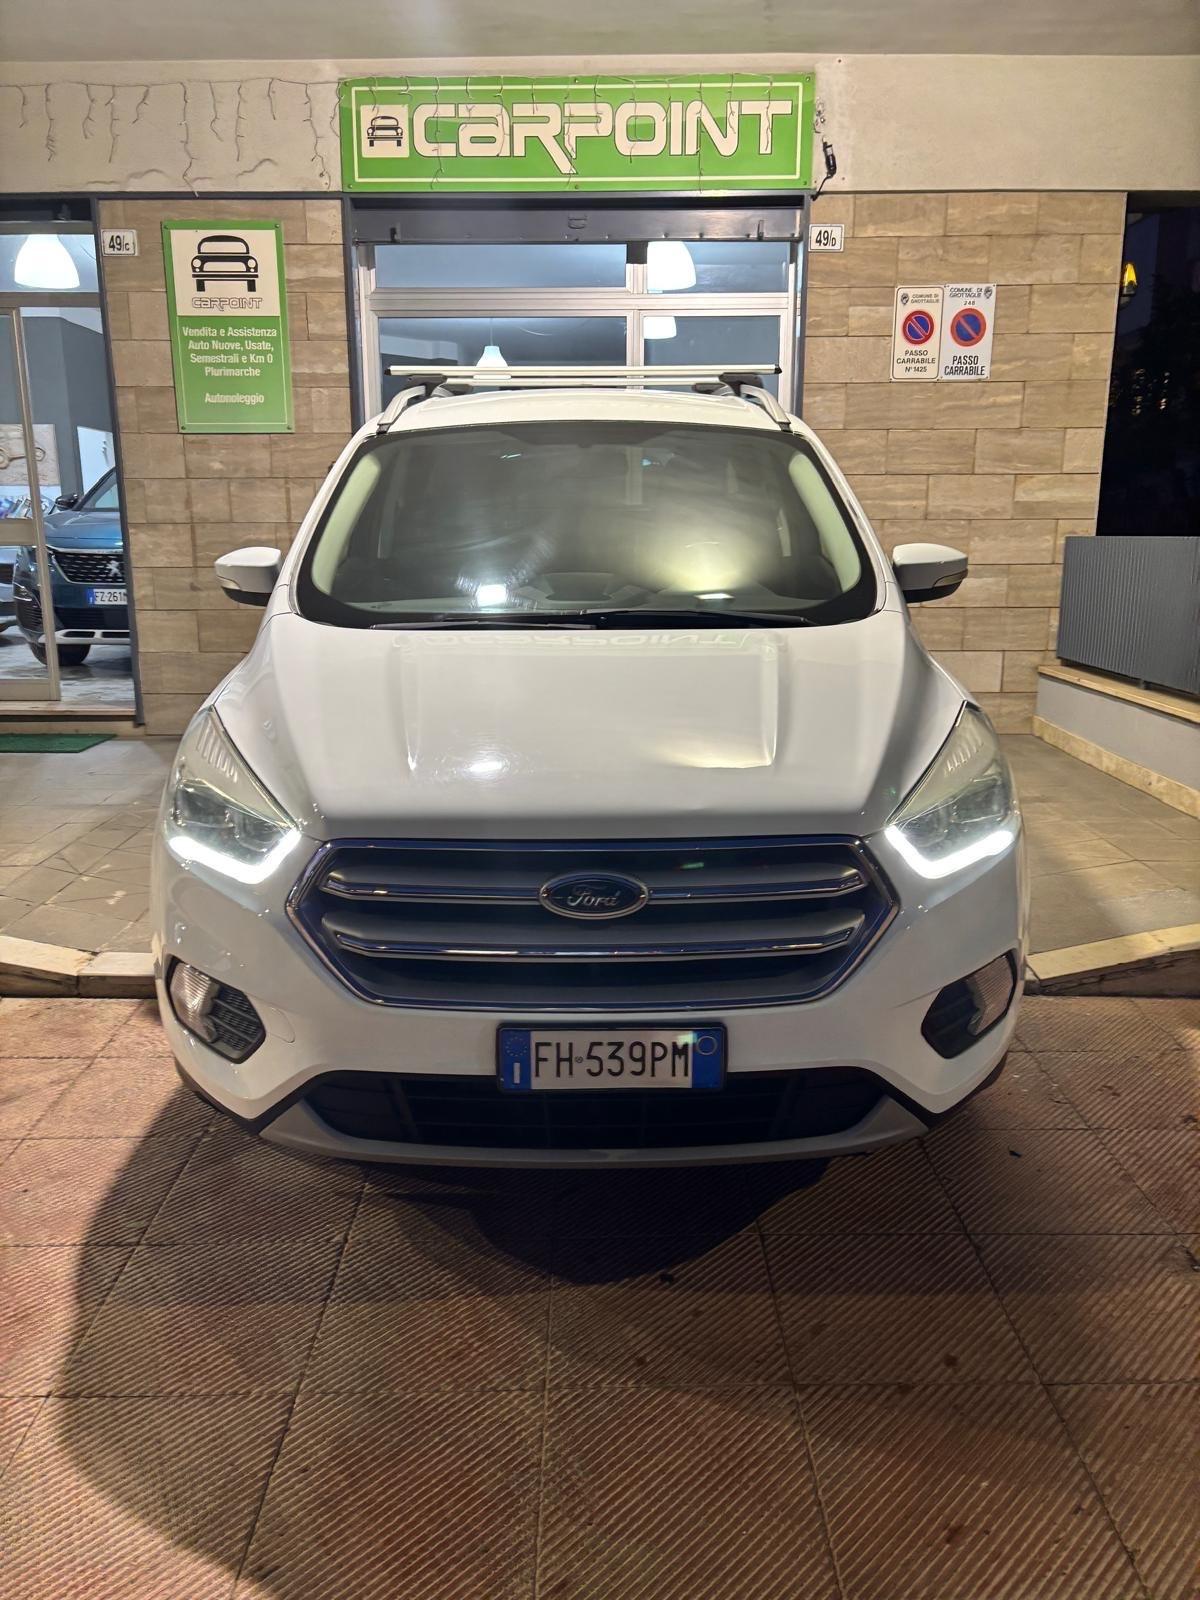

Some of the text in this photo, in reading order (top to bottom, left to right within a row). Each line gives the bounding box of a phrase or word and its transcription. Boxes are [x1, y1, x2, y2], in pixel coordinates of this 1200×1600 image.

[182, 326, 277, 337] Vendita e Assistenza
[188, 340, 274, 352] Auto Nuove, Usate,
[190, 354, 240, 364] Semestrali
[250, 354, 265, 364] Km
[952, 355, 979, 366] PASSO
[204, 366, 260, 376] Plurimarche
[944, 366, 986, 376] CARRABILE
[204, 393, 264, 405] Autonoleggio
[567, 884, 621, 907] Ford
